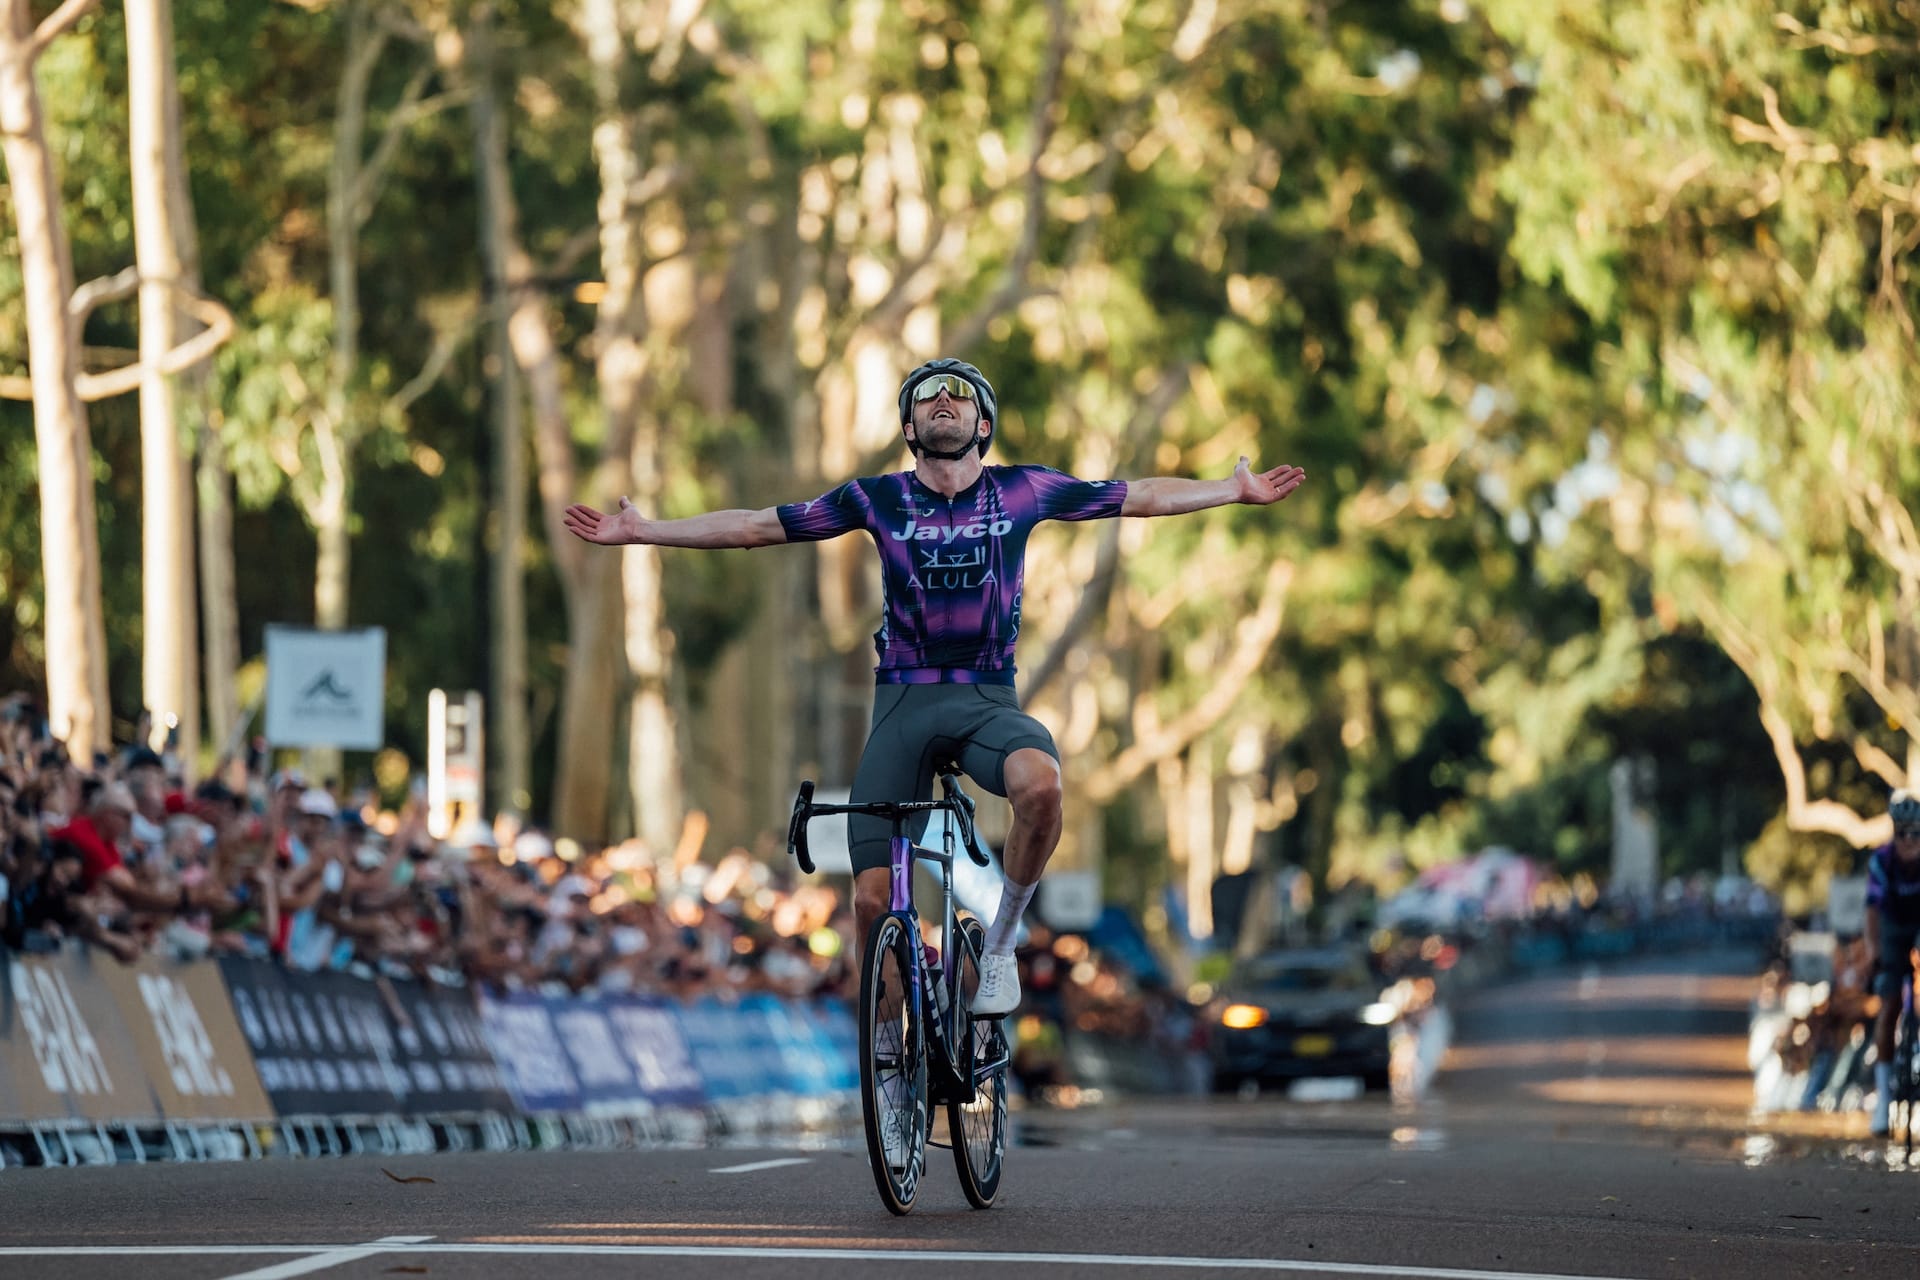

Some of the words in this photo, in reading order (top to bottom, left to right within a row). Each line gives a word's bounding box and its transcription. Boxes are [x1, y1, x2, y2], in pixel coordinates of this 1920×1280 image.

[891, 520, 1013, 544] Jayco
[905, 569, 998, 591] ALULA
[899, 801, 938, 809] CADEX
